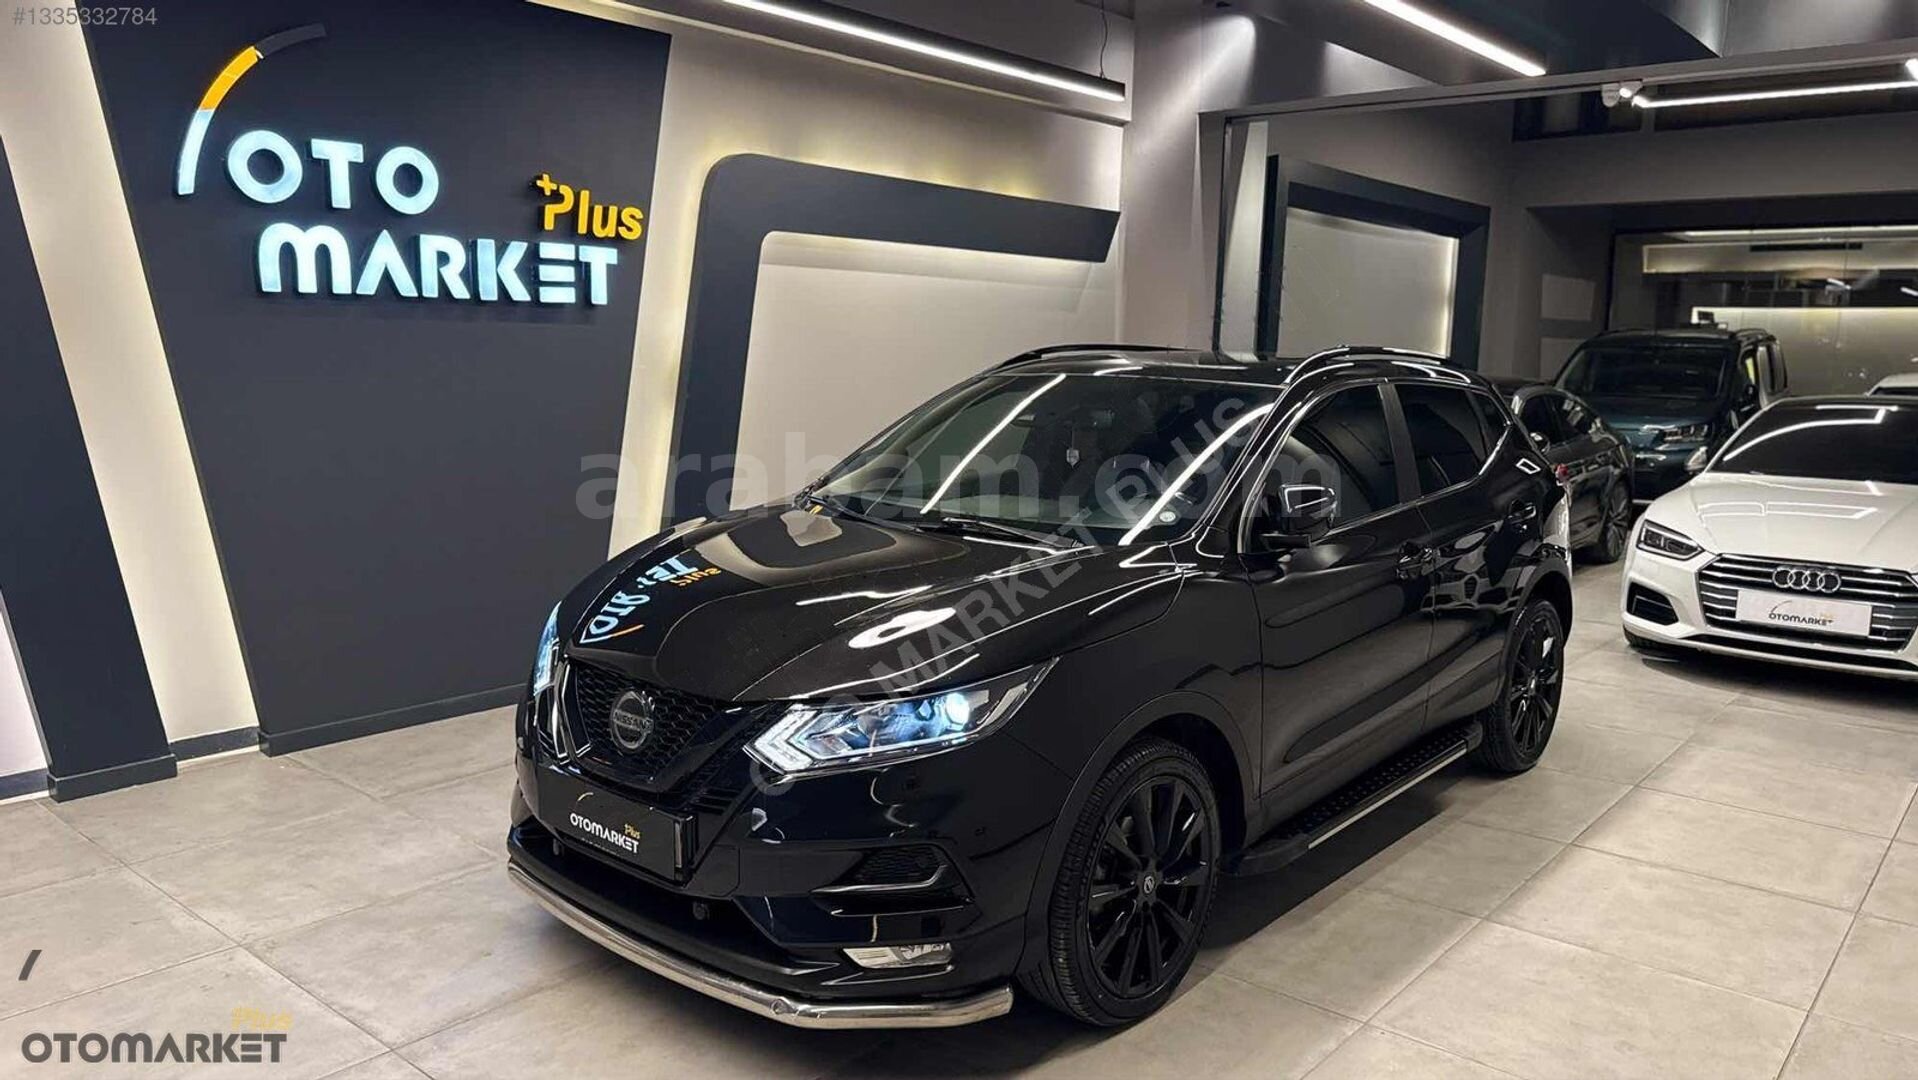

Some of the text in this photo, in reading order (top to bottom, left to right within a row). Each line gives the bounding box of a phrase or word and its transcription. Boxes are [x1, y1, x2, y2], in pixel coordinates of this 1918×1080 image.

[226, 129, 440, 215] OTO
[258, 222, 618, 306] MARKET
[569, 812, 640, 854] OTOMARKET
